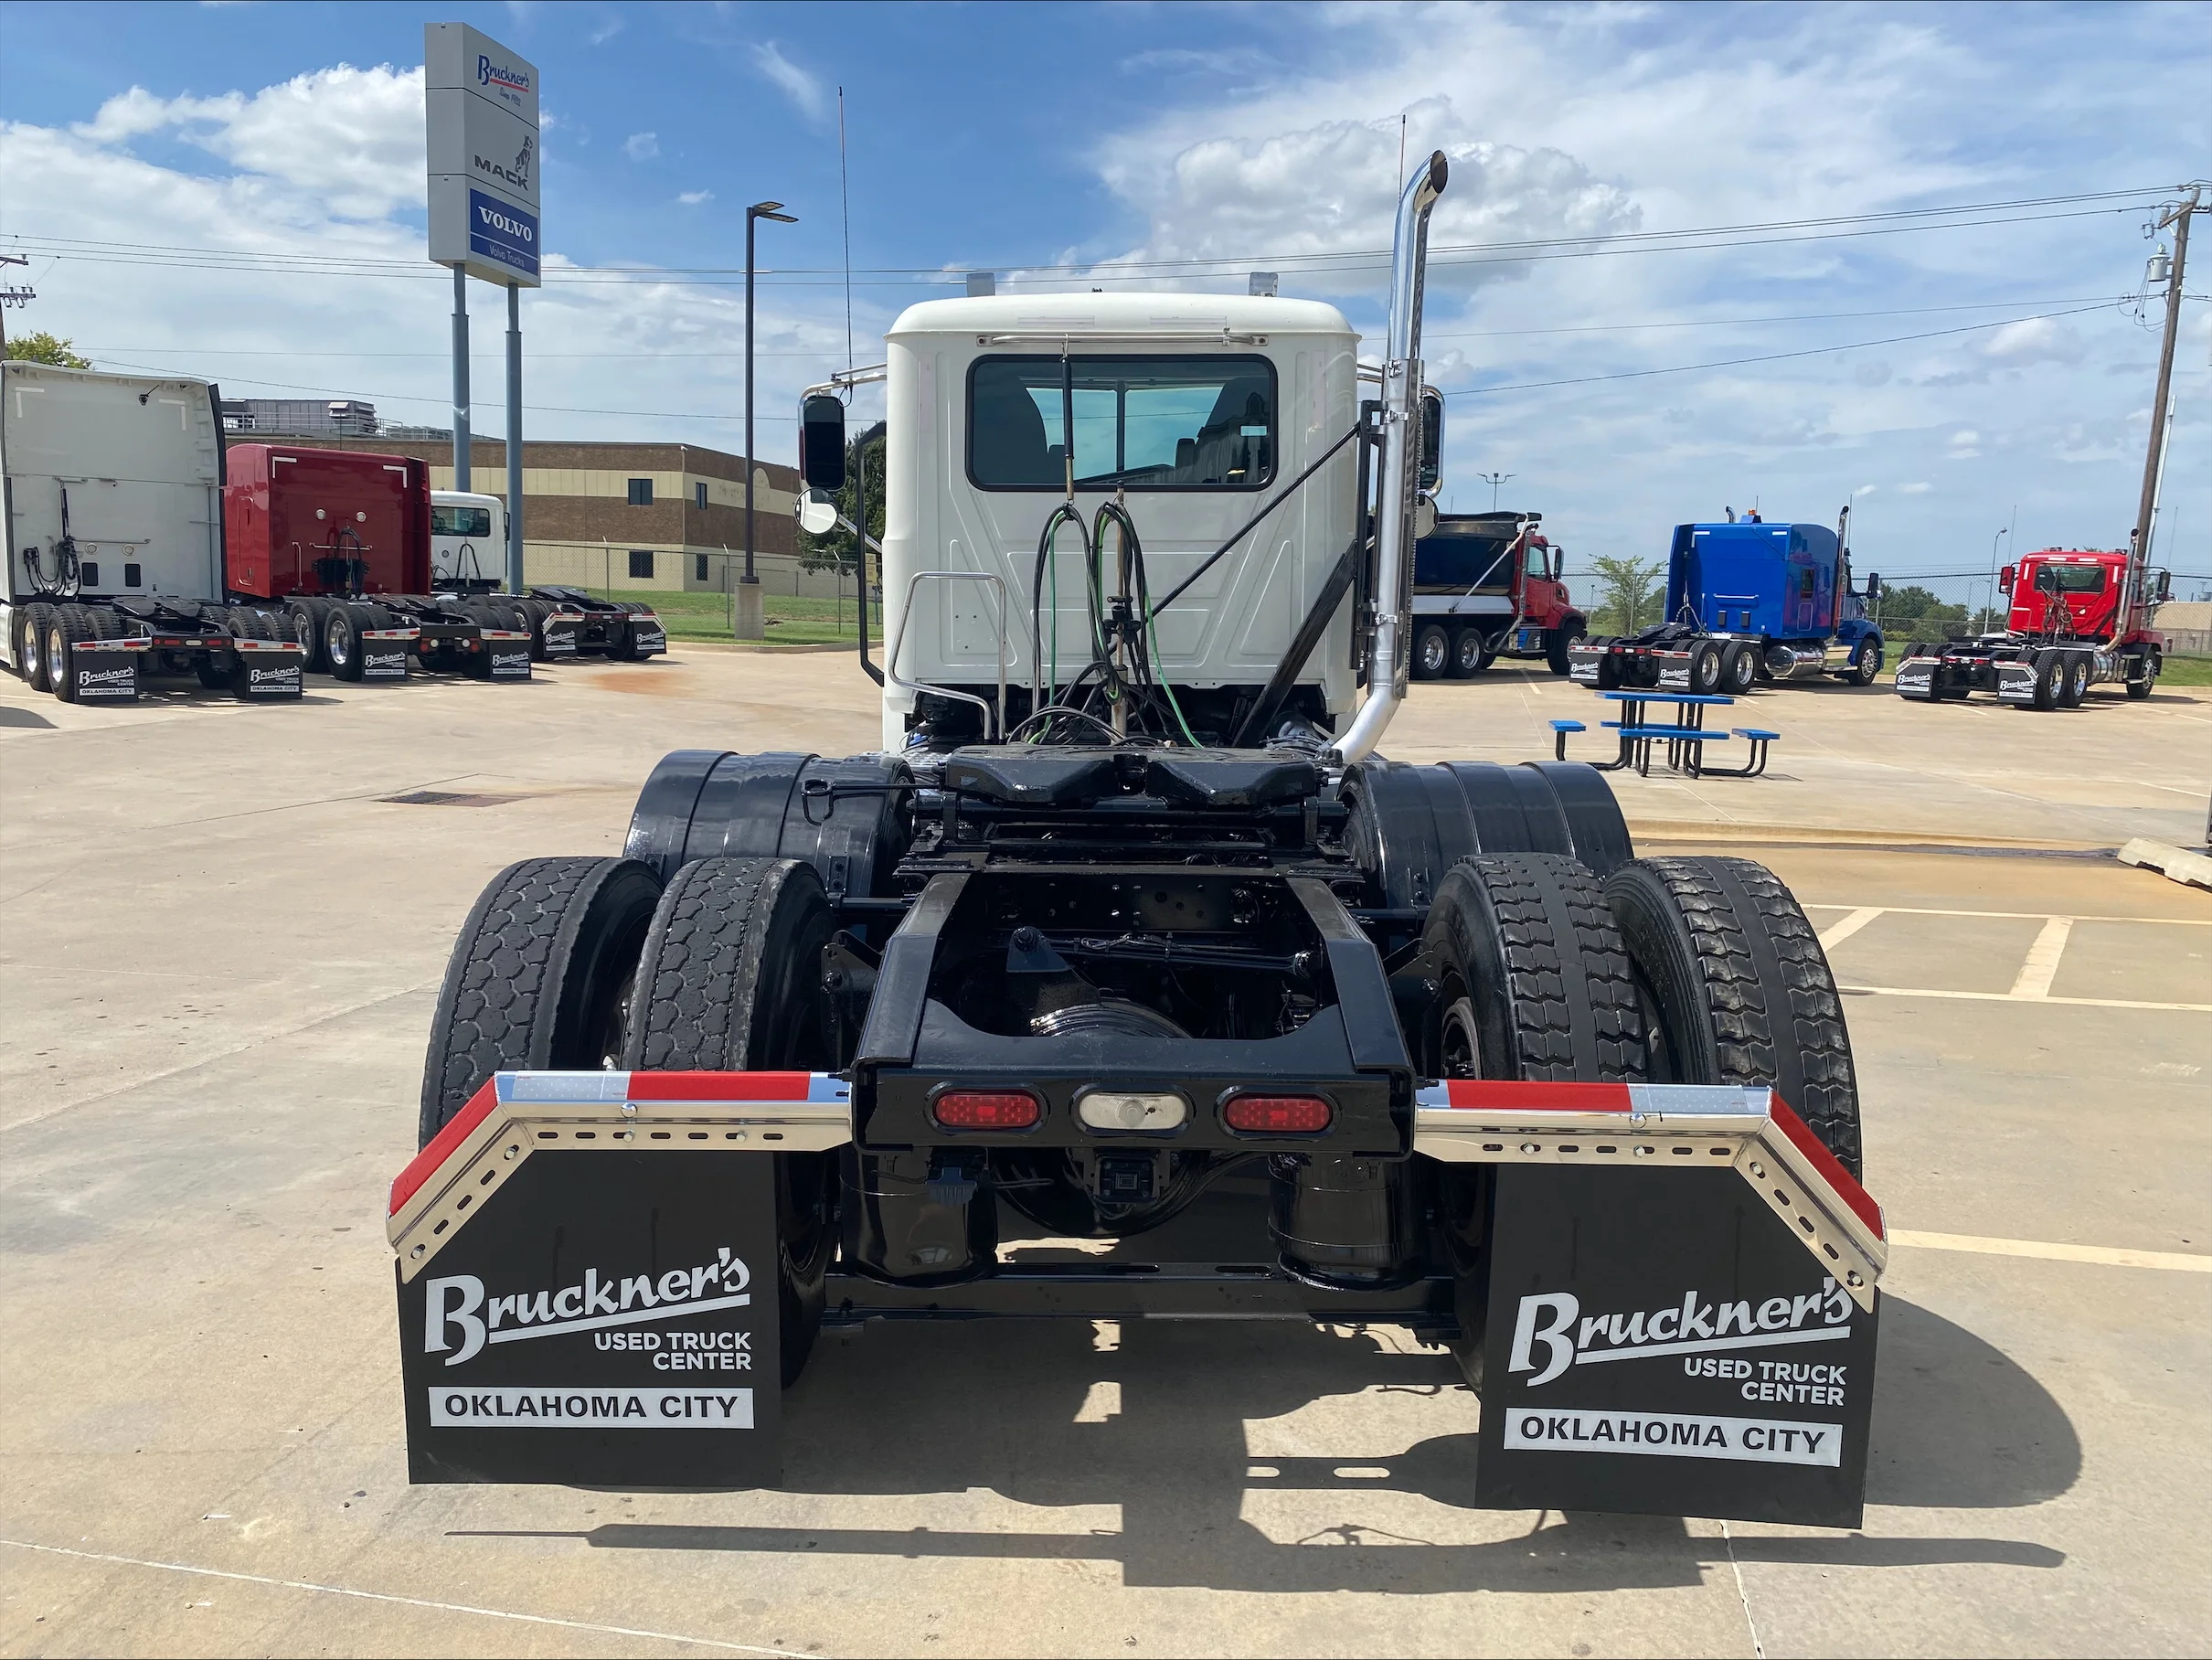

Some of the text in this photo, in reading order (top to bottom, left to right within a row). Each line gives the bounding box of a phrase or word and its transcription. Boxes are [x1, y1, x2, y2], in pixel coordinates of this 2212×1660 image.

[477, 54, 529, 88] Bruckner's
[474, 154, 529, 191] MACK
[478, 206, 533, 242] VOLVO
[489, 243, 526, 268] Volvo Trucks
[79, 665, 134, 686] Bruckner's
[250, 665, 300, 684] Bruckner's
[424, 1246, 750, 1367] Bruckner's
[594, 1332, 752, 1351] USED TRUCK
[1508, 1277, 1854, 1388] Bruckner's
[653, 1352, 752, 1370] CENTER
[1684, 1357, 1847, 1386] USED TRUCK
[444, 1394, 739, 1418] OKLAHOMA CITY
[1740, 1380, 1846, 1407] CENTER
[1520, 1416, 1826, 1453] OKLAHOMA CITY
